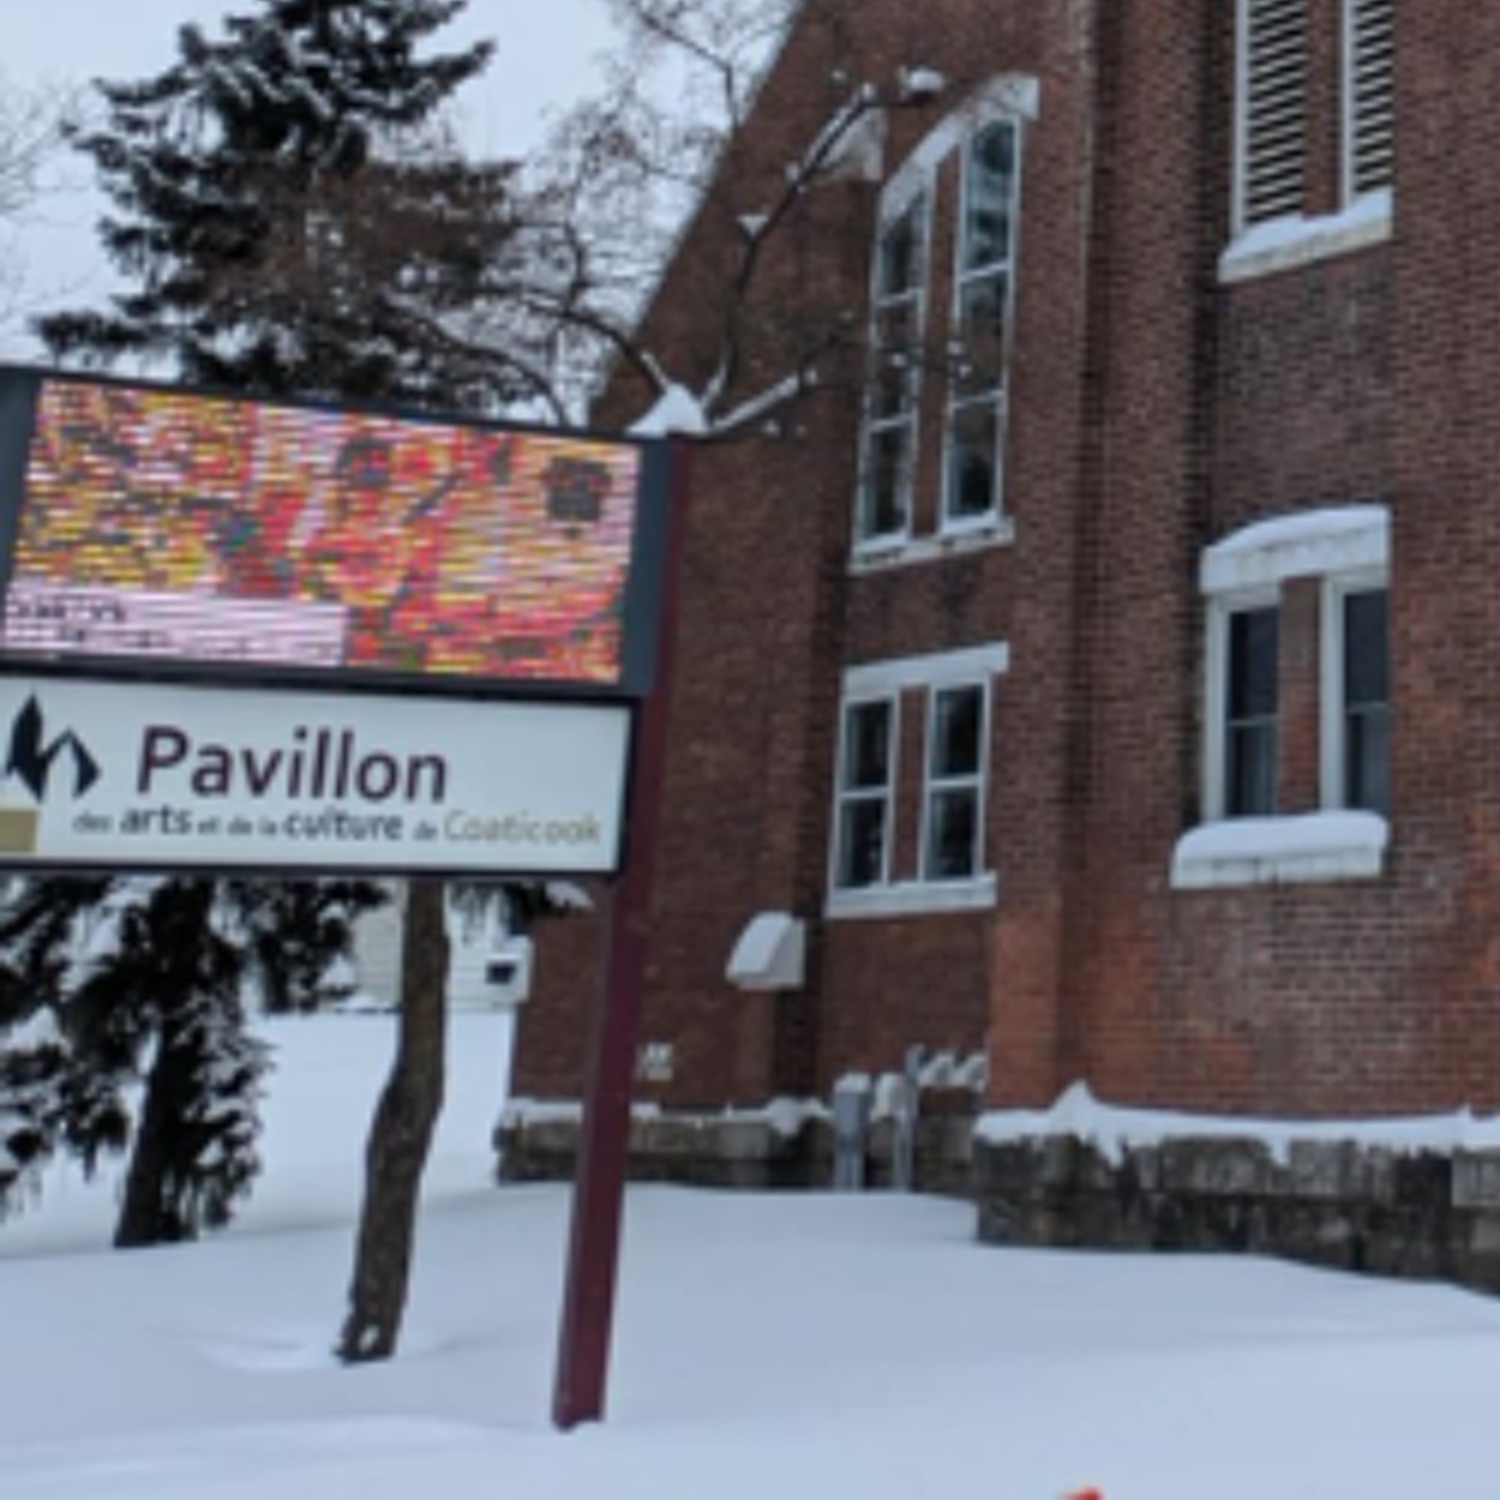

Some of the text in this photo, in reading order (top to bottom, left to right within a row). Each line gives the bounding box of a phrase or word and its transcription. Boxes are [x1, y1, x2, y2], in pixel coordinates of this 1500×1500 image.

[136, 724, 449, 803] Pavillon
[73, 804, 601, 845] des arts et de la culture de Coaticook
